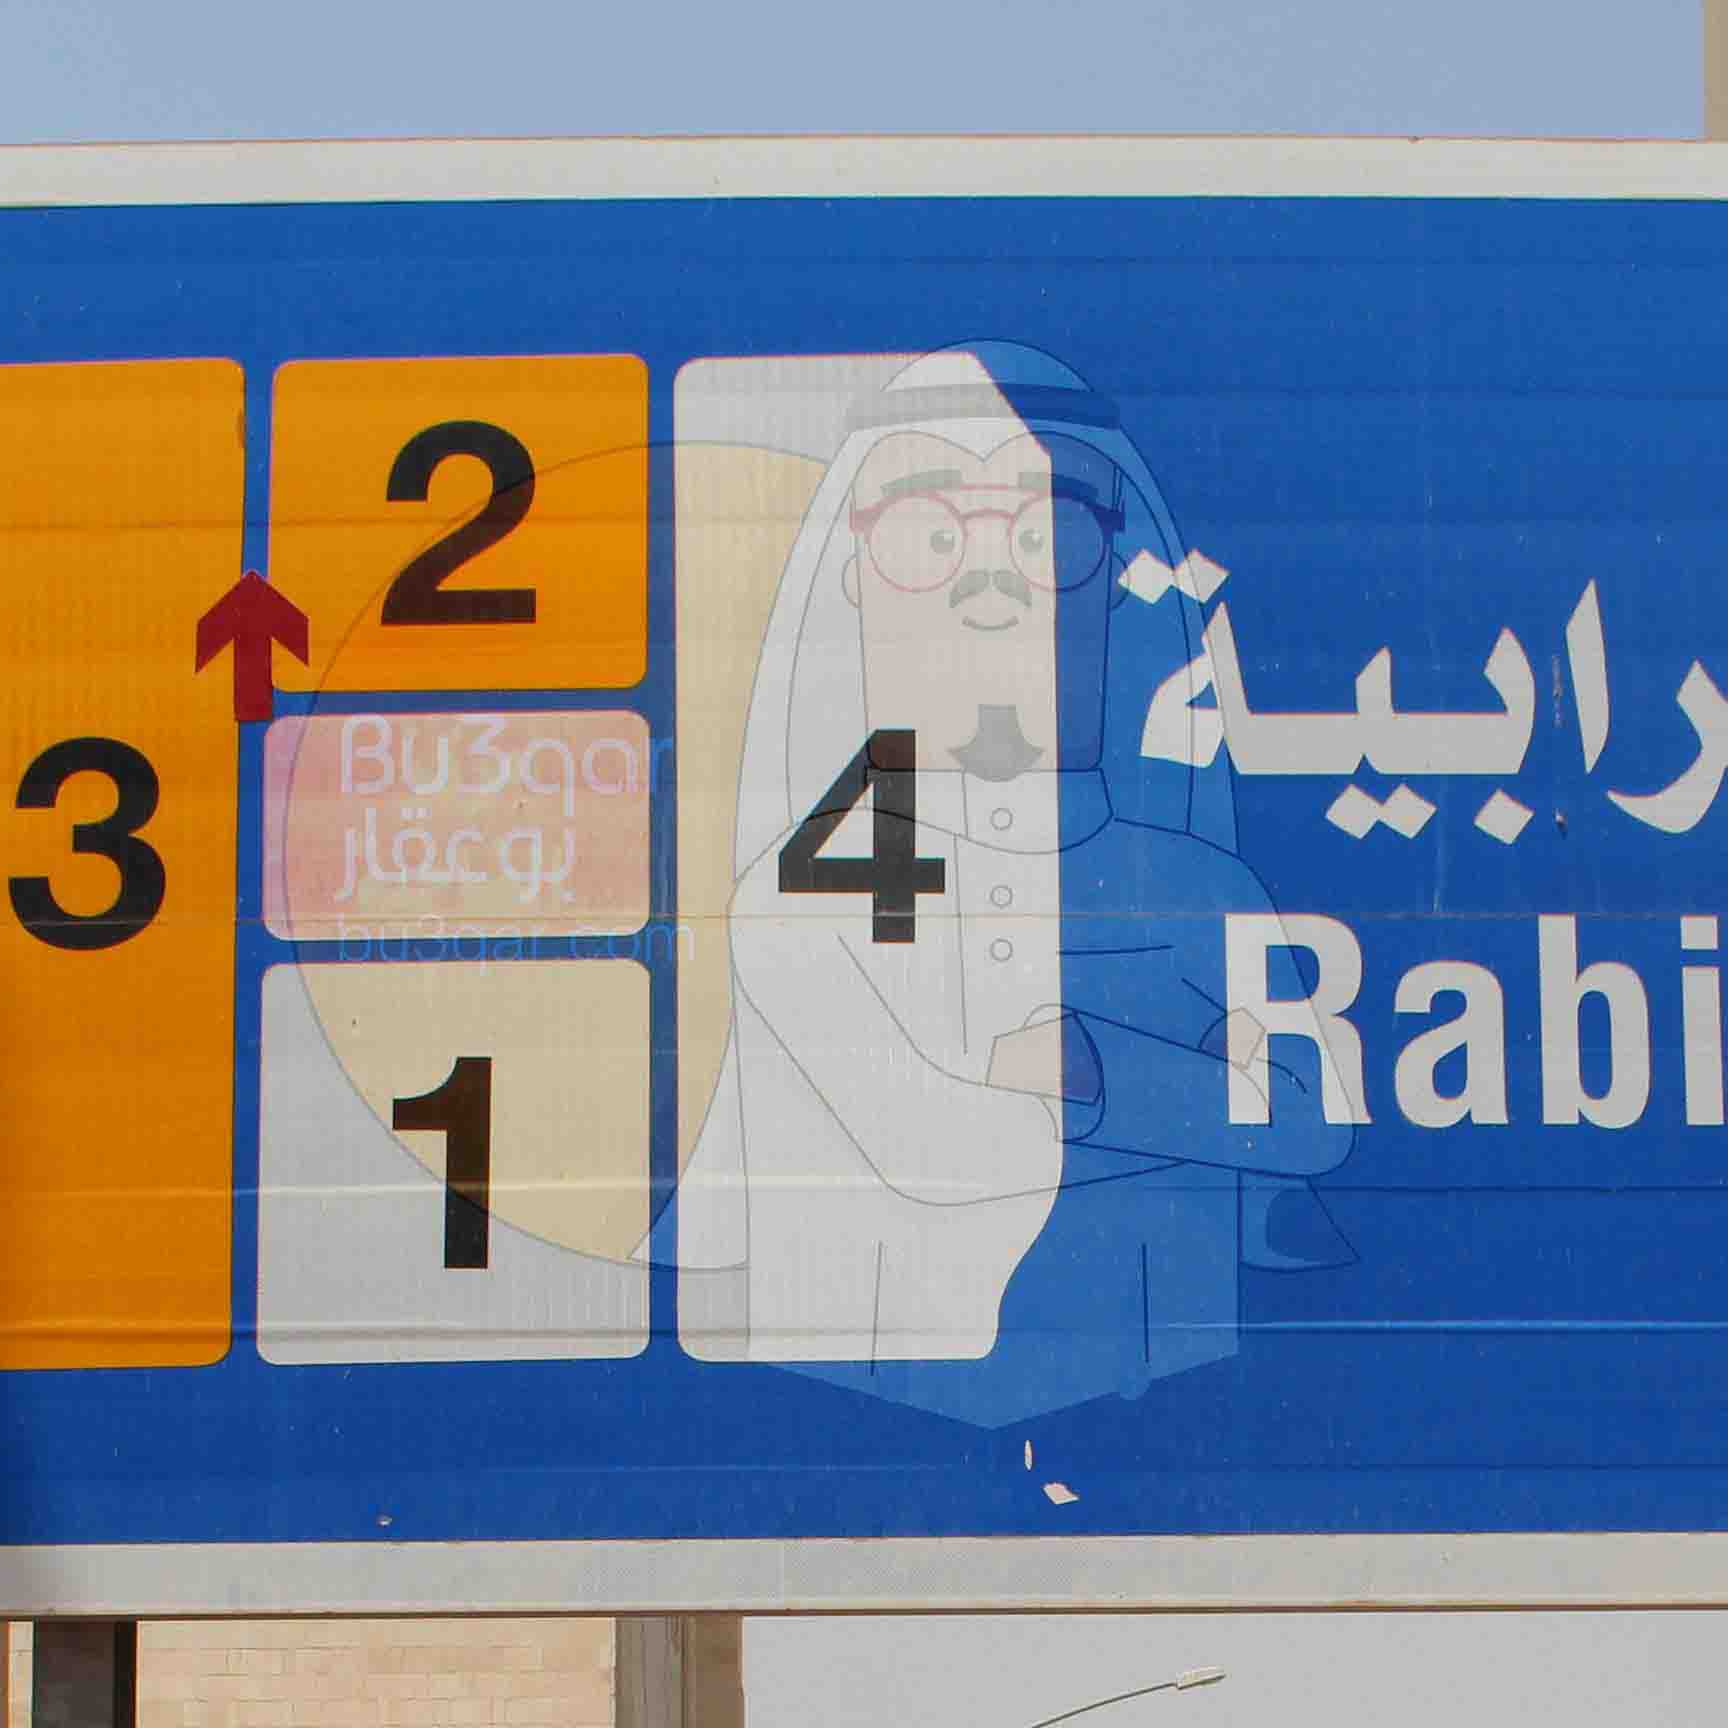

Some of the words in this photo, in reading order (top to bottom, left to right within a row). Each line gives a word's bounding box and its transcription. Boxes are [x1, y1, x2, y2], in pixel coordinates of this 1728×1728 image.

[380, 420, 537, 626] 2
[8, 737, 166, 952] 3
[778, 729, 946, 944] 4
[391, 1057, 493, 1270] 1
